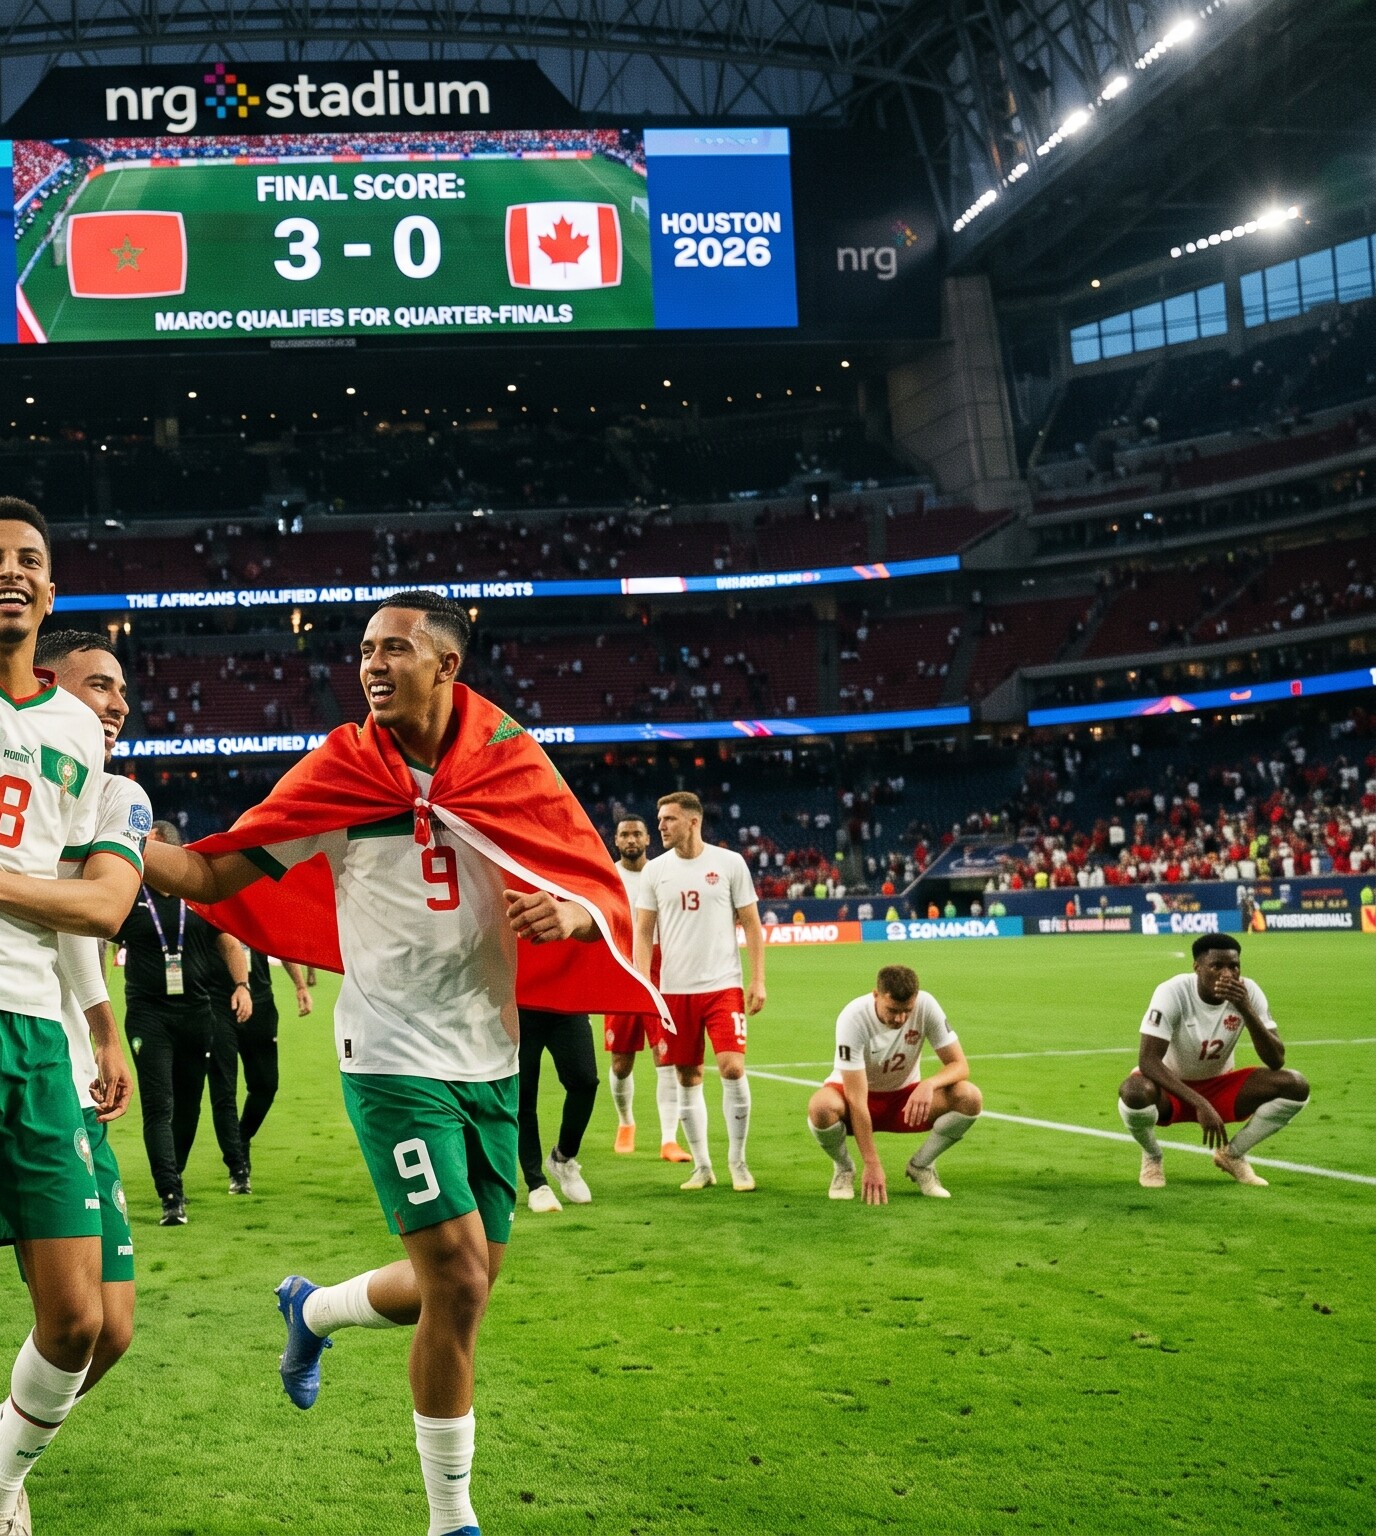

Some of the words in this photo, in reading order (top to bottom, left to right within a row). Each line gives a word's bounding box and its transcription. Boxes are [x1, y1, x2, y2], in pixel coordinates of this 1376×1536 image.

[105, 84, 198, 133] nrg
[265, 69, 491, 119] stadium
[256, 175, 348, 202] FINAL
[353, 172, 466, 200] SCORE:
[661, 212, 782, 234] HOUSTON
[272, 216, 322, 281] 3
[392, 214, 442, 279] 0
[674, 236, 772, 267] 2026
[837, 246, 898, 280] nrg
[155, 308, 233, 331] MAROC
[236, 307, 345, 330] QUALIFIES
[348, 306, 391, 326] FOR
[394, 304, 573, 327] QUARTER-FINALS
[126, 593, 158, 609] THE
[160, 590, 236, 608] AFRICANS
[237, 588, 317, 607] QUALIFIED
[319, 587, 353, 603] AND
[450, 583, 481, 599] THE
[483, 581, 534, 598] HOSTS
[132, 738, 216, 756] AFRICANS
[218, 735, 306, 756] QUALIFIED
[421, 845, 461, 912] 9
[680, 890, 701, 911] 13
[883, 1053, 906, 1074] 12
[1198, 1039, 1224, 1061] 12
[393, 1137, 441, 1205] 9
